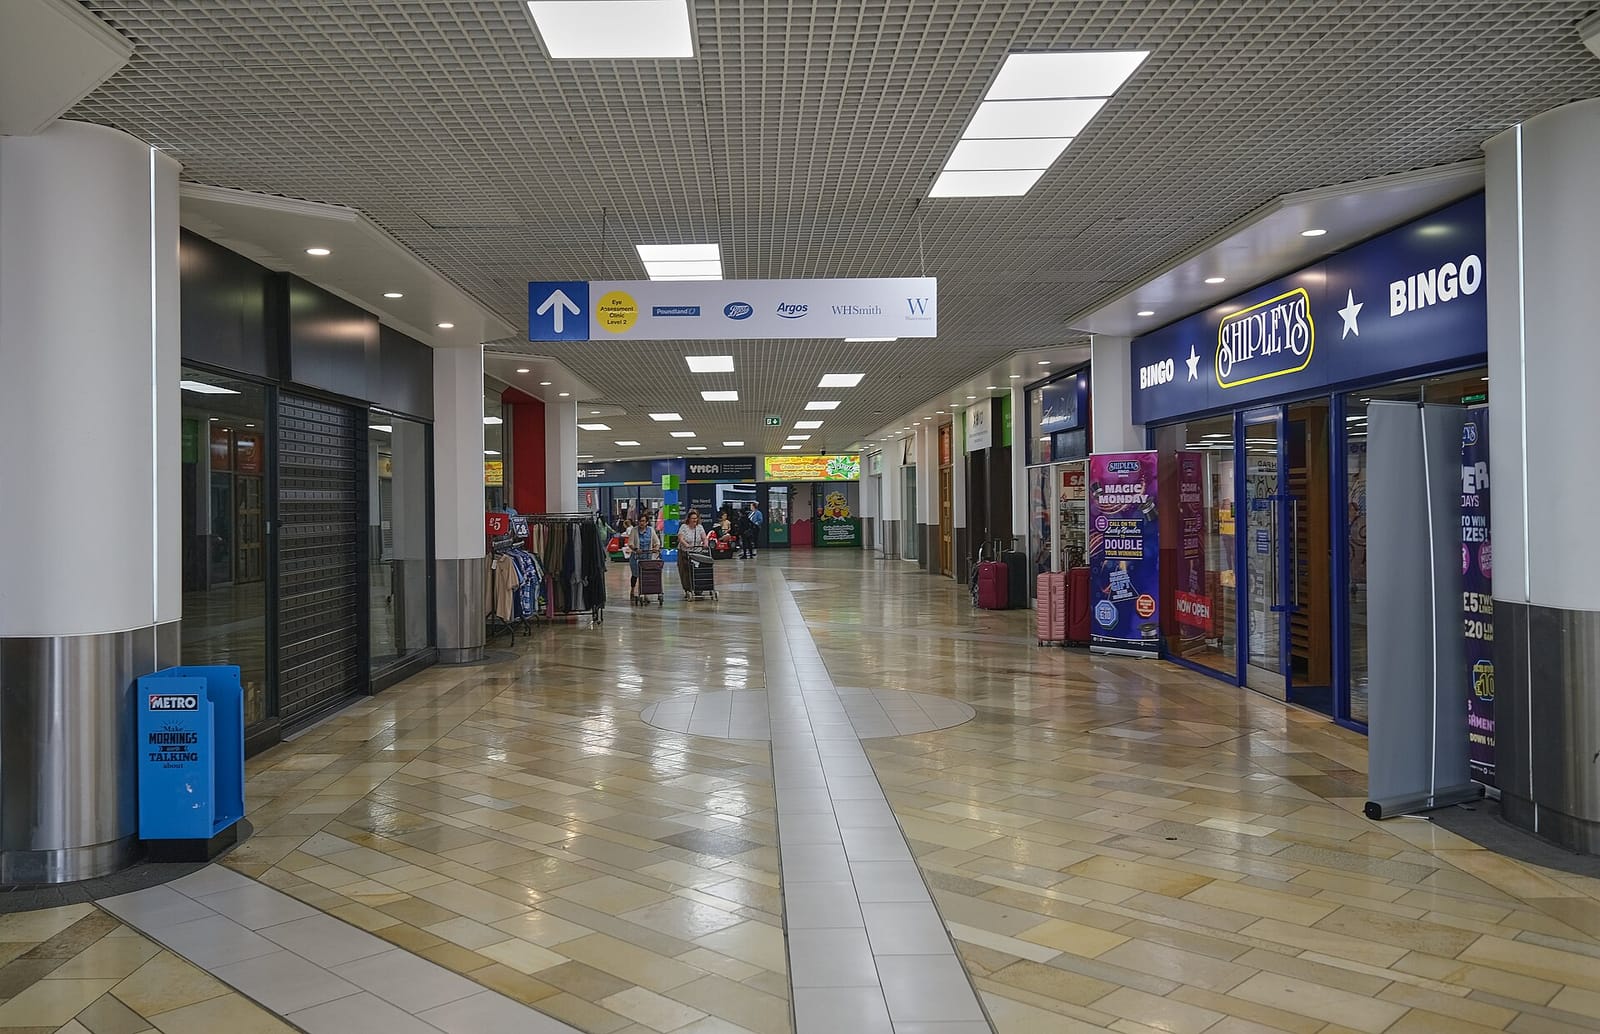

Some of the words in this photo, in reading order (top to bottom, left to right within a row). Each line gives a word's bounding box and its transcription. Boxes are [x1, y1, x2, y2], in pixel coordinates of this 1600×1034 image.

[1389, 254, 1482, 317] BINGO
[777, 302, 808, 314] Argos
[832, 305, 882, 316] WHSmith
[907, 298, 929, 315] W
[1219, 297, 1309, 378] SHIPLEYS
[1140, 358, 1174, 390] BINGO
[690, 464, 718, 474] YMCA
[1109, 461, 1139, 472] SHIPLEYS
[1104, 484, 1141, 494] MAGIC
[1098, 494, 1149, 504] MONDAY
[489, 517, 502, 531] £5
[1471, 516, 1486, 527] WIN
[1104, 539, 1143, 550] DOUBLE
[1463, 591, 1479, 613] £5
[1176, 599, 1191, 613] NOW
[1192, 602, 1210, 618] OPEN
[151, 696, 196, 709] METRO
[149, 732, 198, 744] MORNINGS
[148, 752, 198, 762] TALKING
